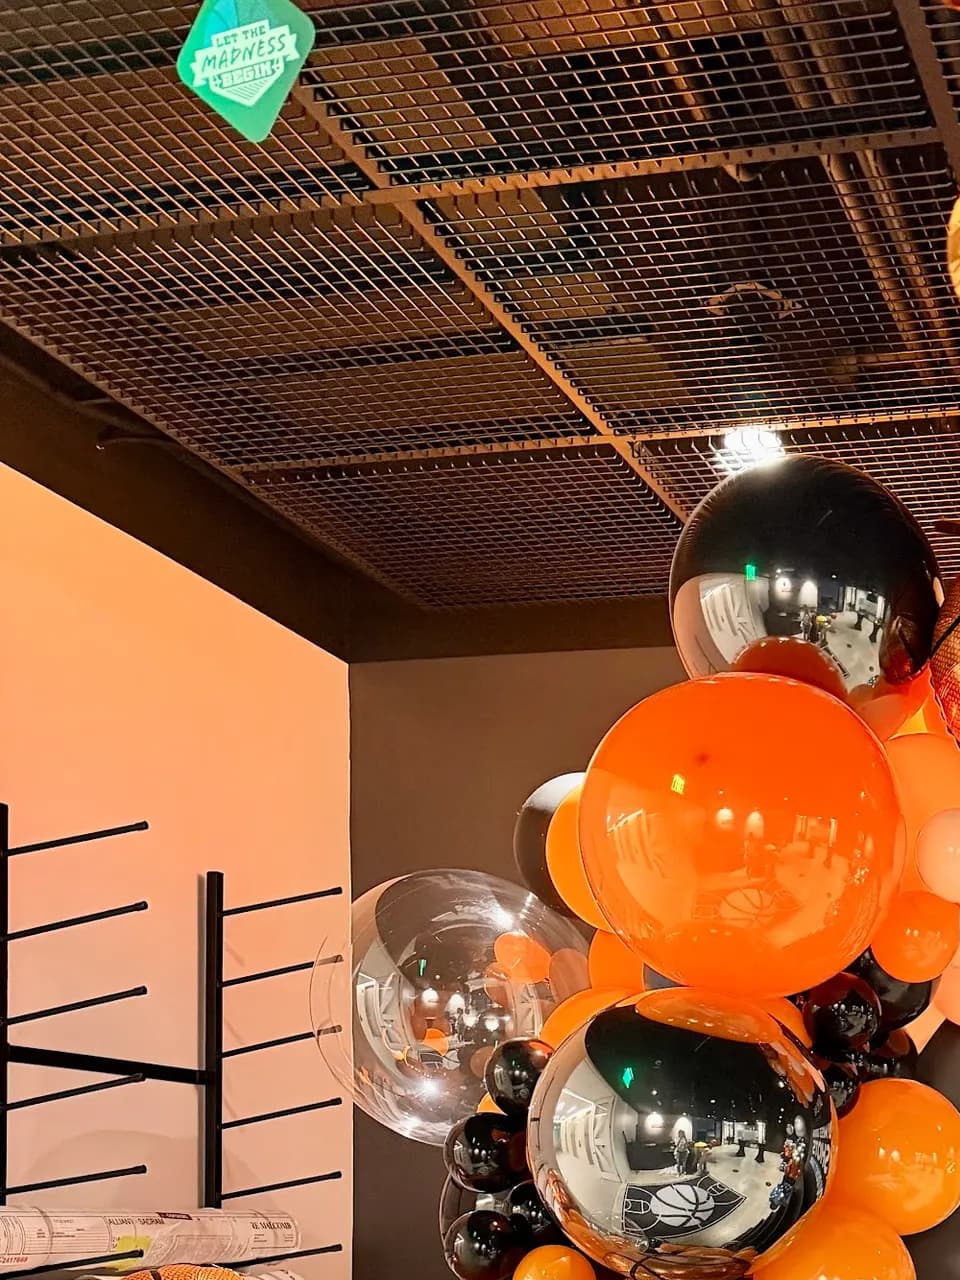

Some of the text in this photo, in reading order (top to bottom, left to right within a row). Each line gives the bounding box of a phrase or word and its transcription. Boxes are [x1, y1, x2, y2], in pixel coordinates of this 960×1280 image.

[215, 25, 267, 48] LET THE
[201, 33, 287, 73] MADNESS
[221, 60, 274, 89] BEGIN
